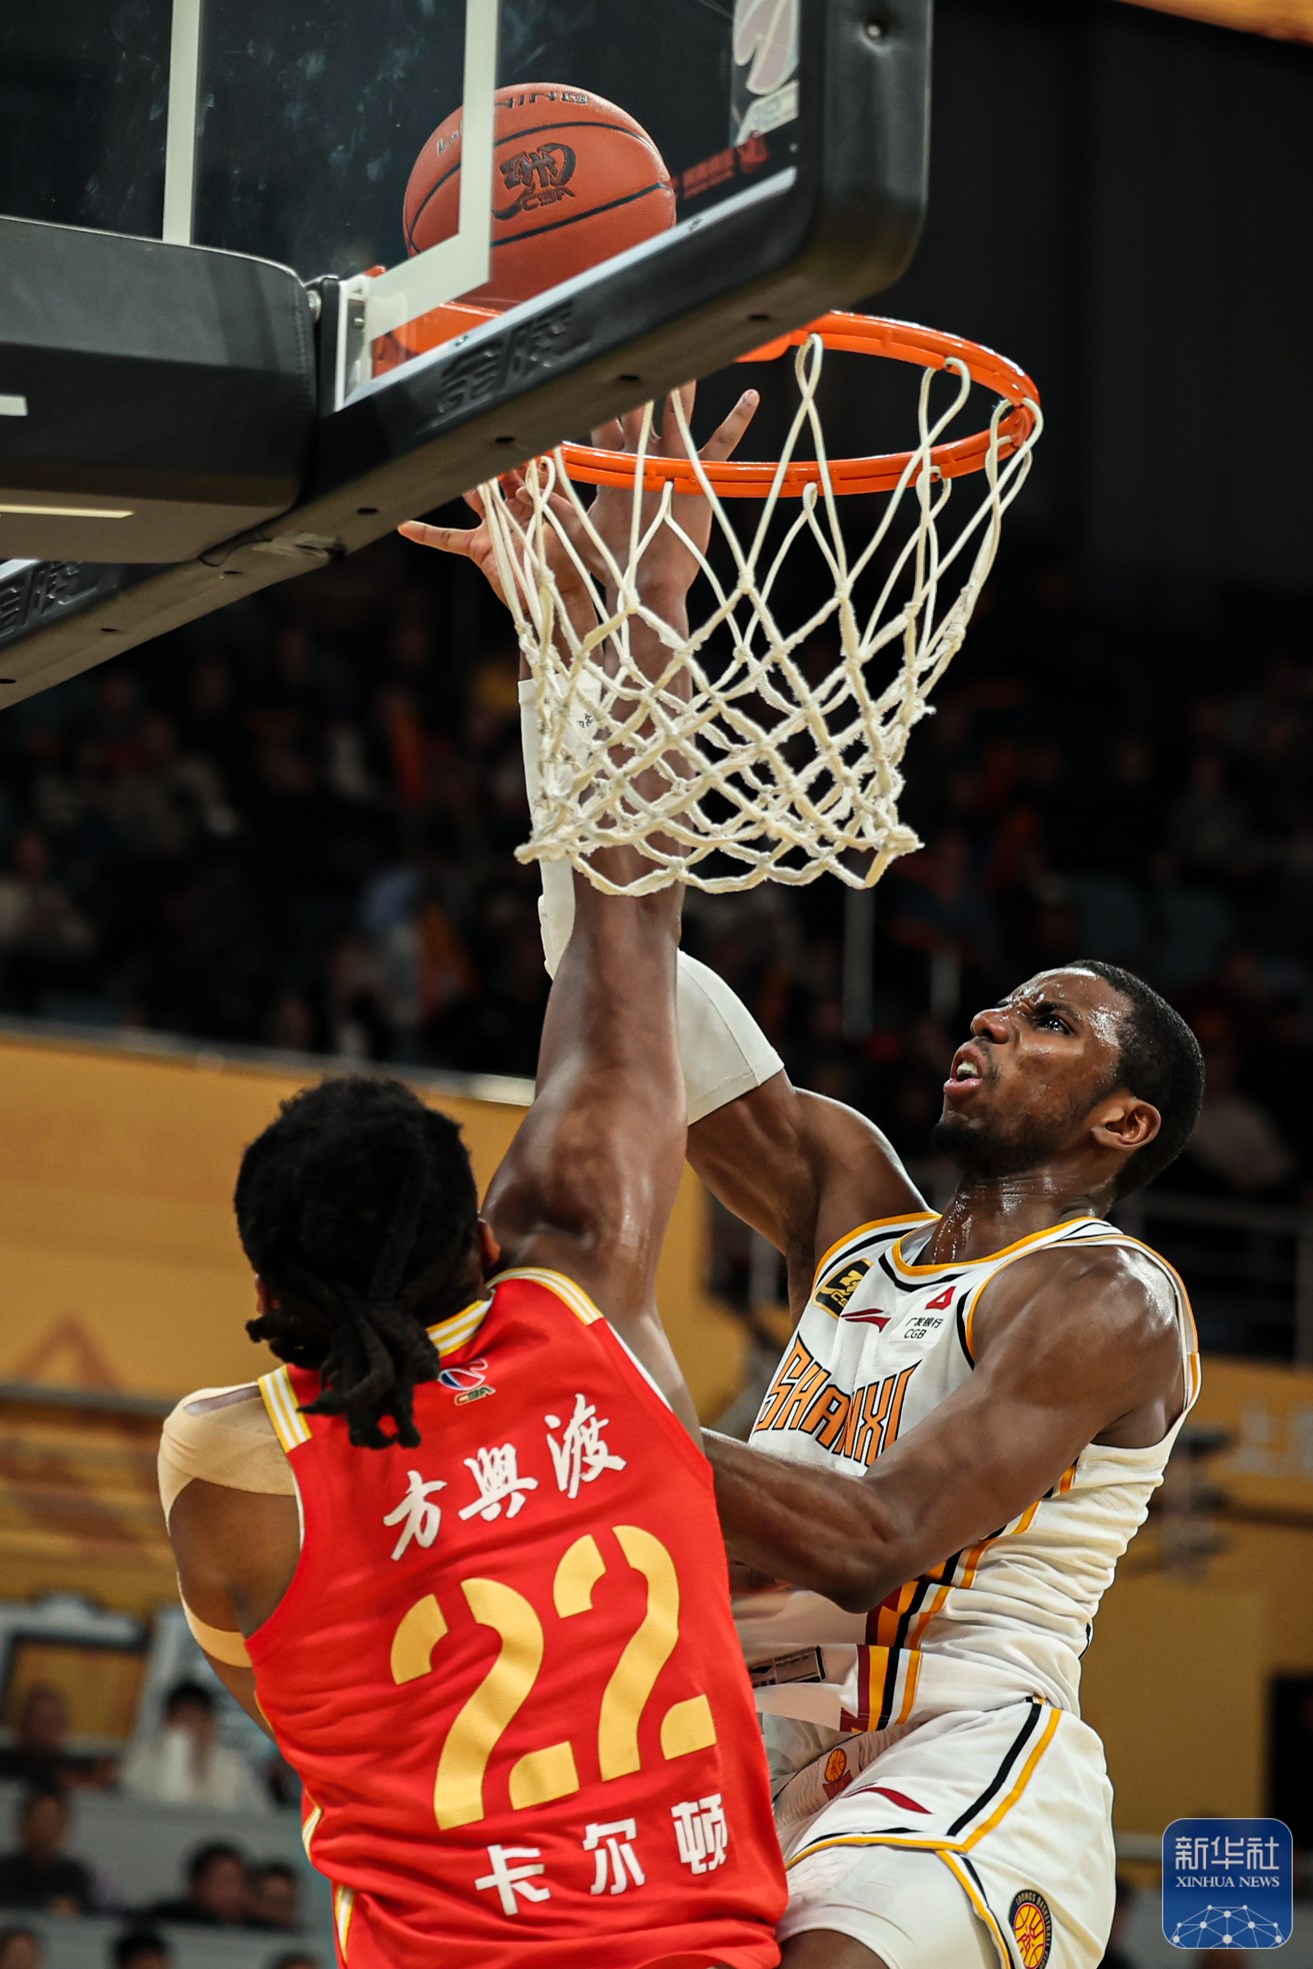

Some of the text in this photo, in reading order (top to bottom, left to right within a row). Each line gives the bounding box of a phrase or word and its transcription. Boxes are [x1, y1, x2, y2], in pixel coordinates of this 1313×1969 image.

[904, 1328, 926, 1339] CGB
[906, 1317, 943, 1329] 广发银行
[454, 1385, 496, 1406] CBA
[752, 1331, 923, 1467] SHANXI
[390, 1524, 717, 1831] 22
[474, 1793, 729, 1916] 卡尔顿
